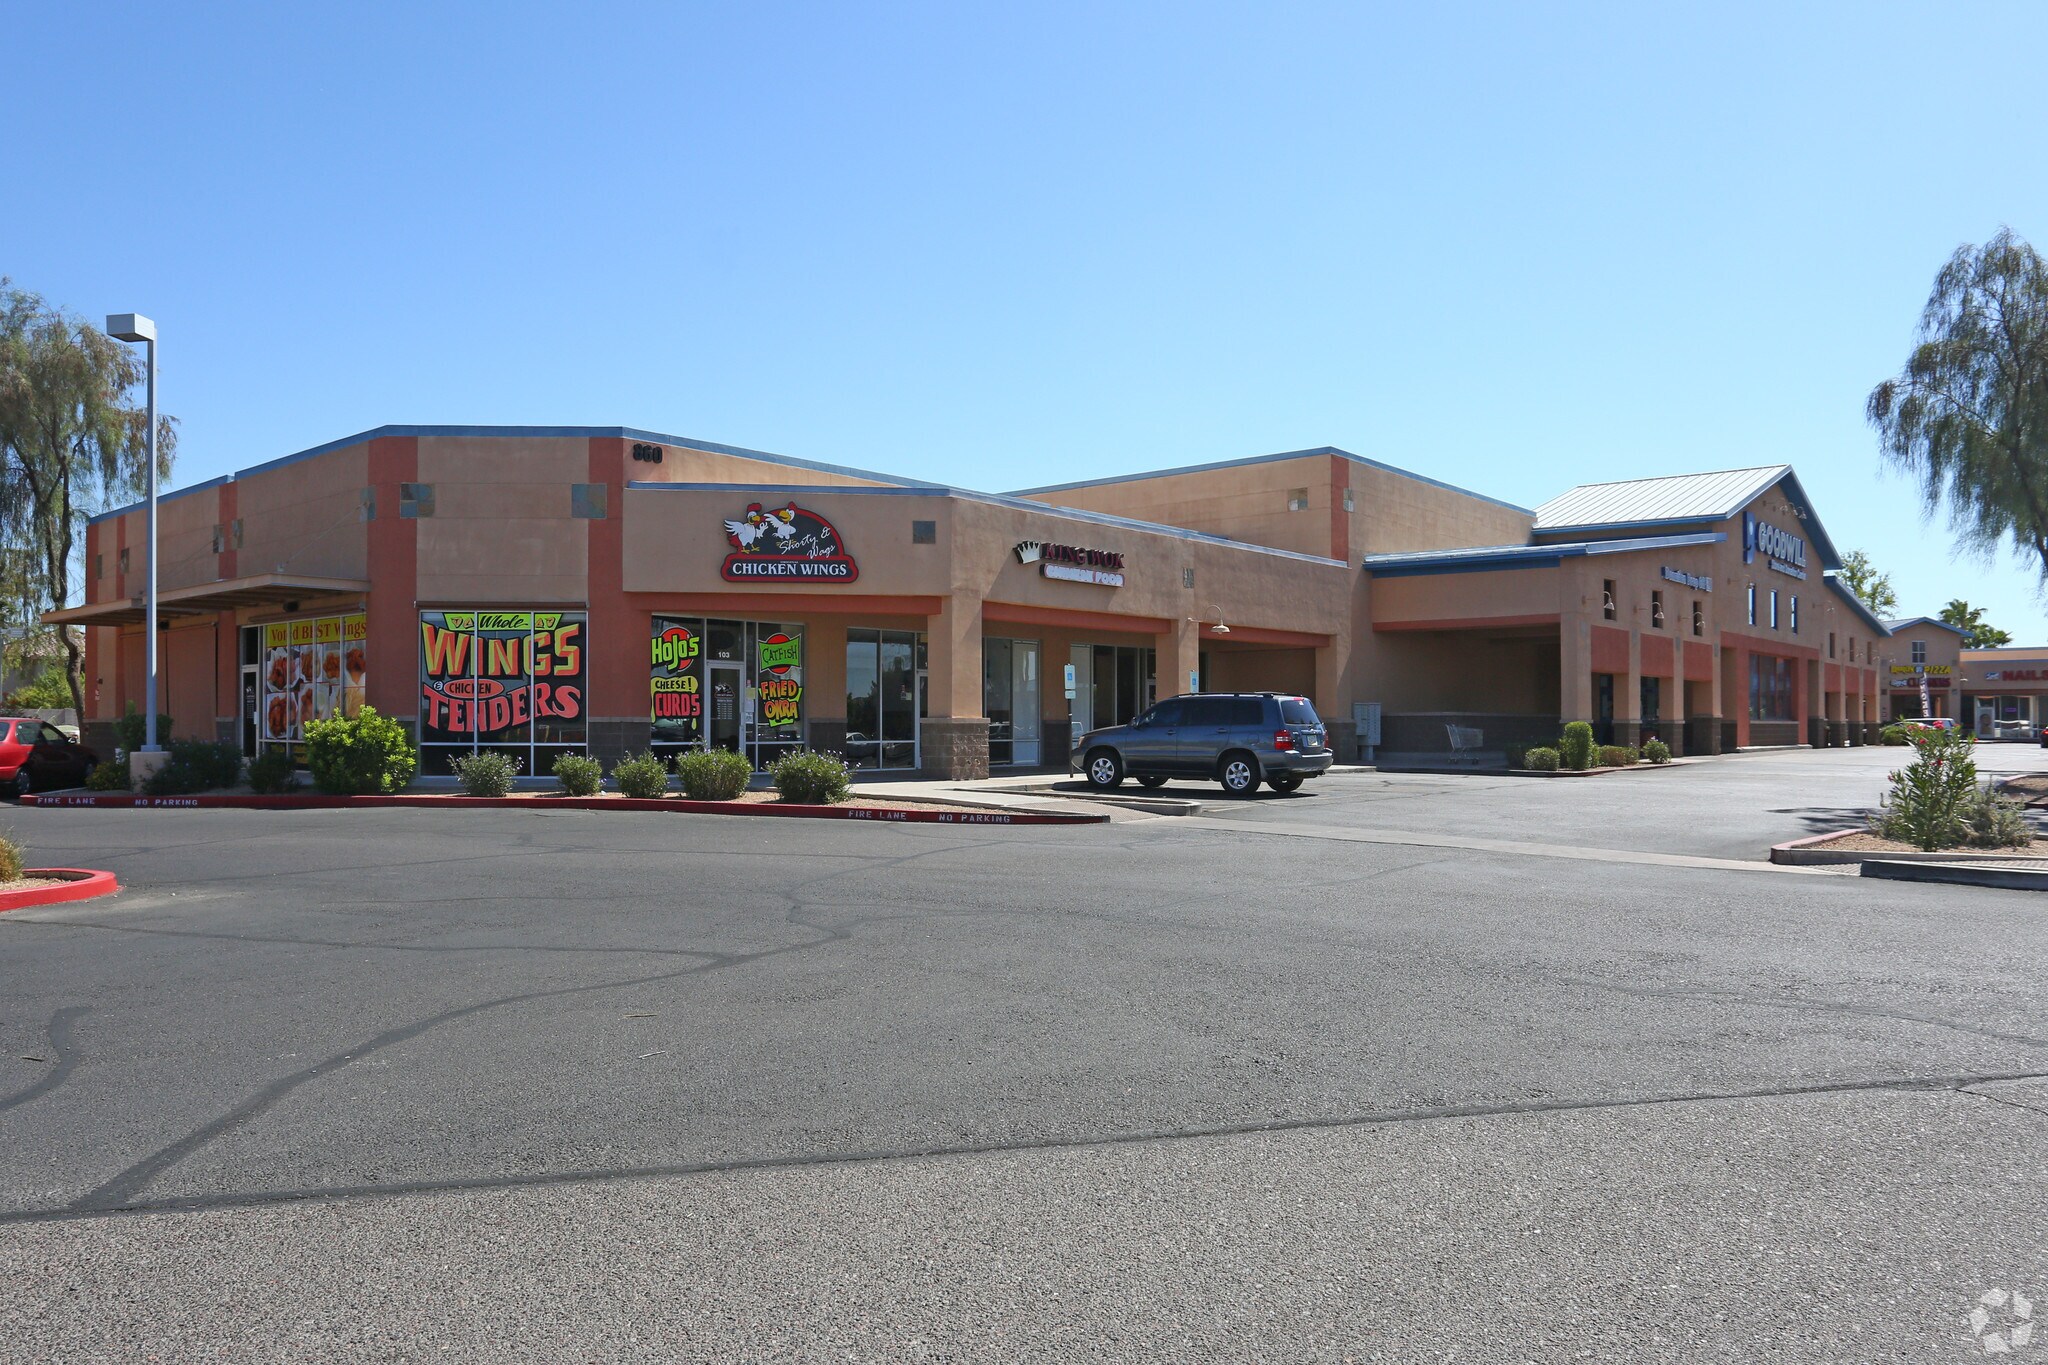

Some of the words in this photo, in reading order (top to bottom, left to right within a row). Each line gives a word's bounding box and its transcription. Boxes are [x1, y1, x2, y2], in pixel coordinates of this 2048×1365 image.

[632, 443, 663, 464] 860
[779, 533, 818, 555] Shorty
[820, 526, 831, 539] &
[1757, 521, 1807, 568] GOODWILL
[806, 544, 836, 559] Wags
[1043, 542, 1087, 565] KING
[1088, 549, 1125, 568] WOK
[732, 563, 797, 576] CHICKEN
[799, 563, 847, 576] WINGS
[271, 626, 299, 642] Votd
[333, 621, 367, 639] Wngs
[480, 614, 529, 629] Whole
[421, 622, 580, 677] WINGS
[718, 651, 730, 659] 103
[761, 644, 798, 665] CATFISH
[1924, 665, 1953, 675] PIZZA
[760, 679, 798, 700] FRIED
[423, 682, 581, 732] TENDERS
[655, 693, 700, 717] CURDS
[764, 699, 798, 721] OKRA
[37, 797, 61, 805] FIRE
[68, 797, 96, 805] LANE
[848, 810, 872, 818] FIRE
[879, 812, 907, 820] LANE
[938, 813, 953, 822] NO
[961, 814, 1011, 823] PARKING
